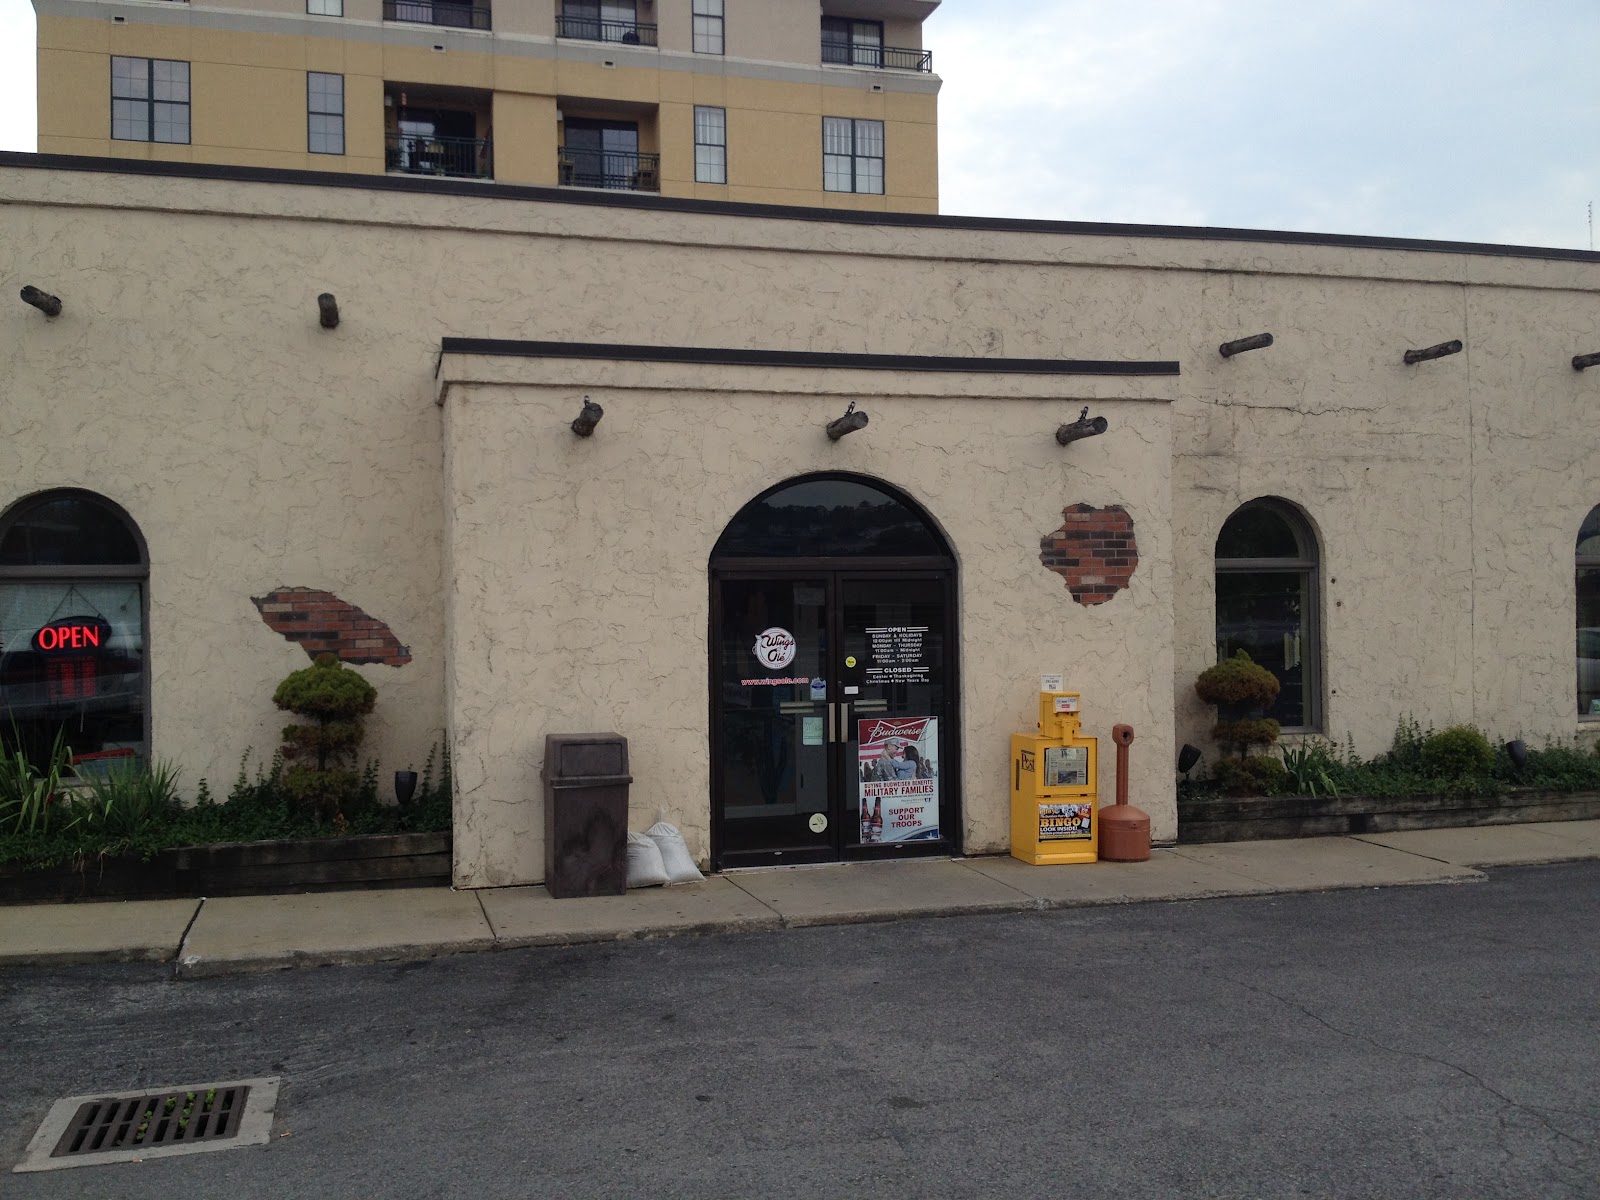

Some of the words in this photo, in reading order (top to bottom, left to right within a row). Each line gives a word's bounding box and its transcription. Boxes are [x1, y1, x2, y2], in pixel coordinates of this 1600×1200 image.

[38, 626, 99, 650] OPEN
[761, 633, 794, 650] Wings
[767, 648, 785, 662] Olé
[741, 677, 809, 686] www.wingsole.com
[868, 726, 925, 738] Budweiser
[864, 788, 898, 796] MILITARY
[902, 785, 934, 794] FAMILIES
[888, 806, 924, 815] SUPPORT
[891, 820, 922, 828] TROOPS
[1040, 817, 1081, 827] BINGO
